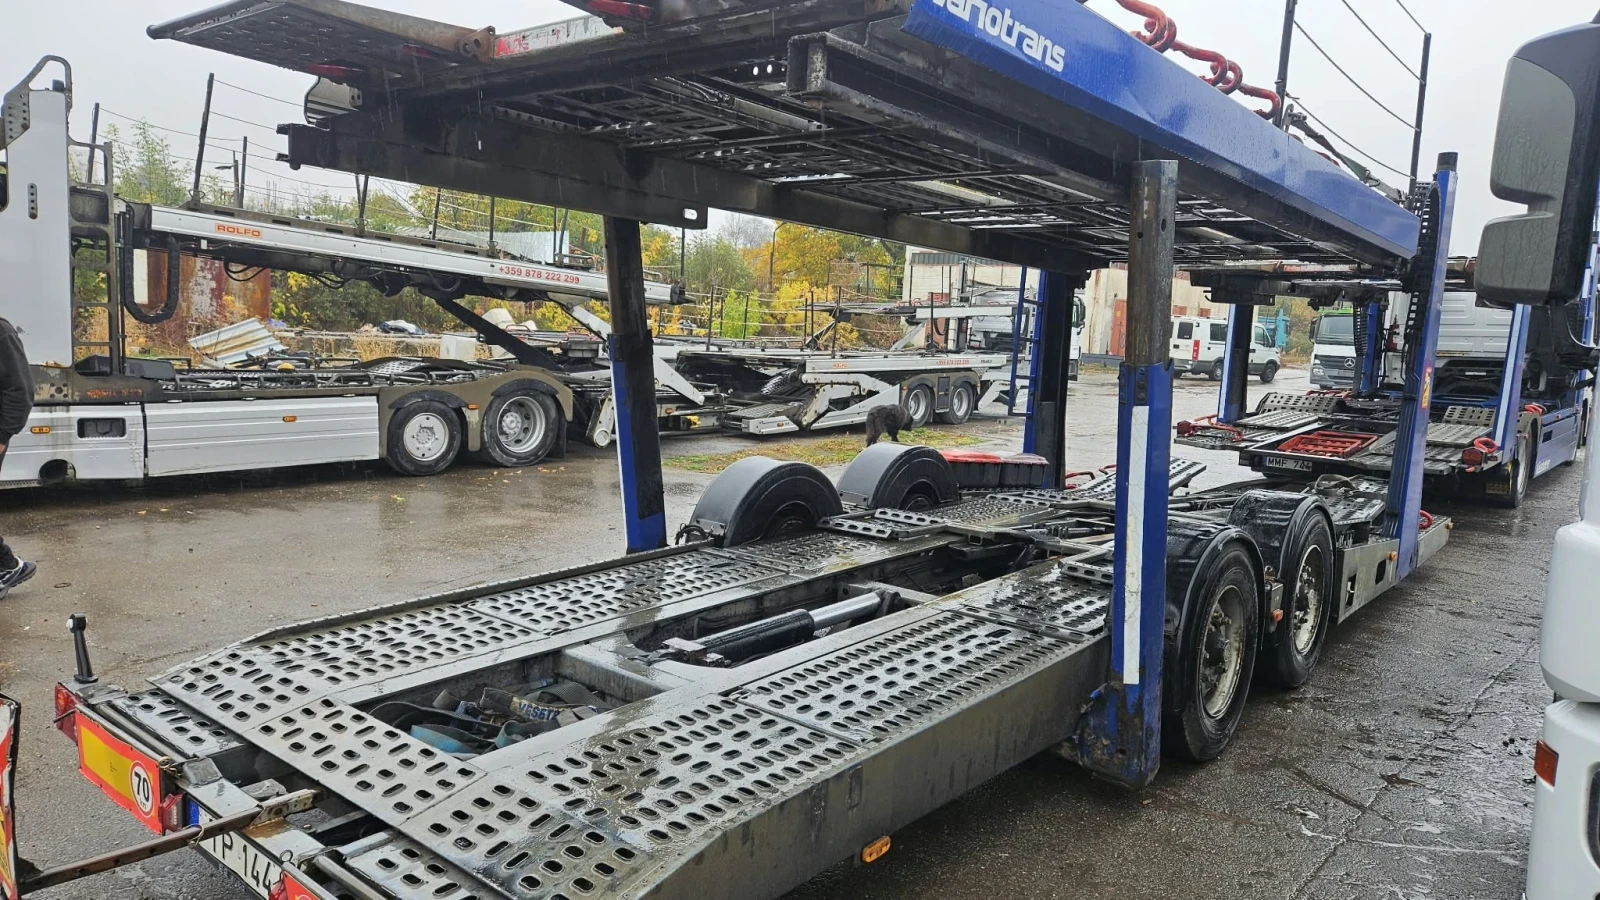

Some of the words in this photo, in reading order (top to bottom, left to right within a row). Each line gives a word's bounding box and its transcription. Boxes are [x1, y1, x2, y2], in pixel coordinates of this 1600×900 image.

[217, 224, 261, 237] ROLFO
[499, 265, 523, 276] +359
[525, 269, 542, 279] 878
[545, 271, 561, 281] 222
[564, 274, 580, 284] 299
[1268, 457, 1288, 467] MMF
[134, 770, 150, 803] 70
